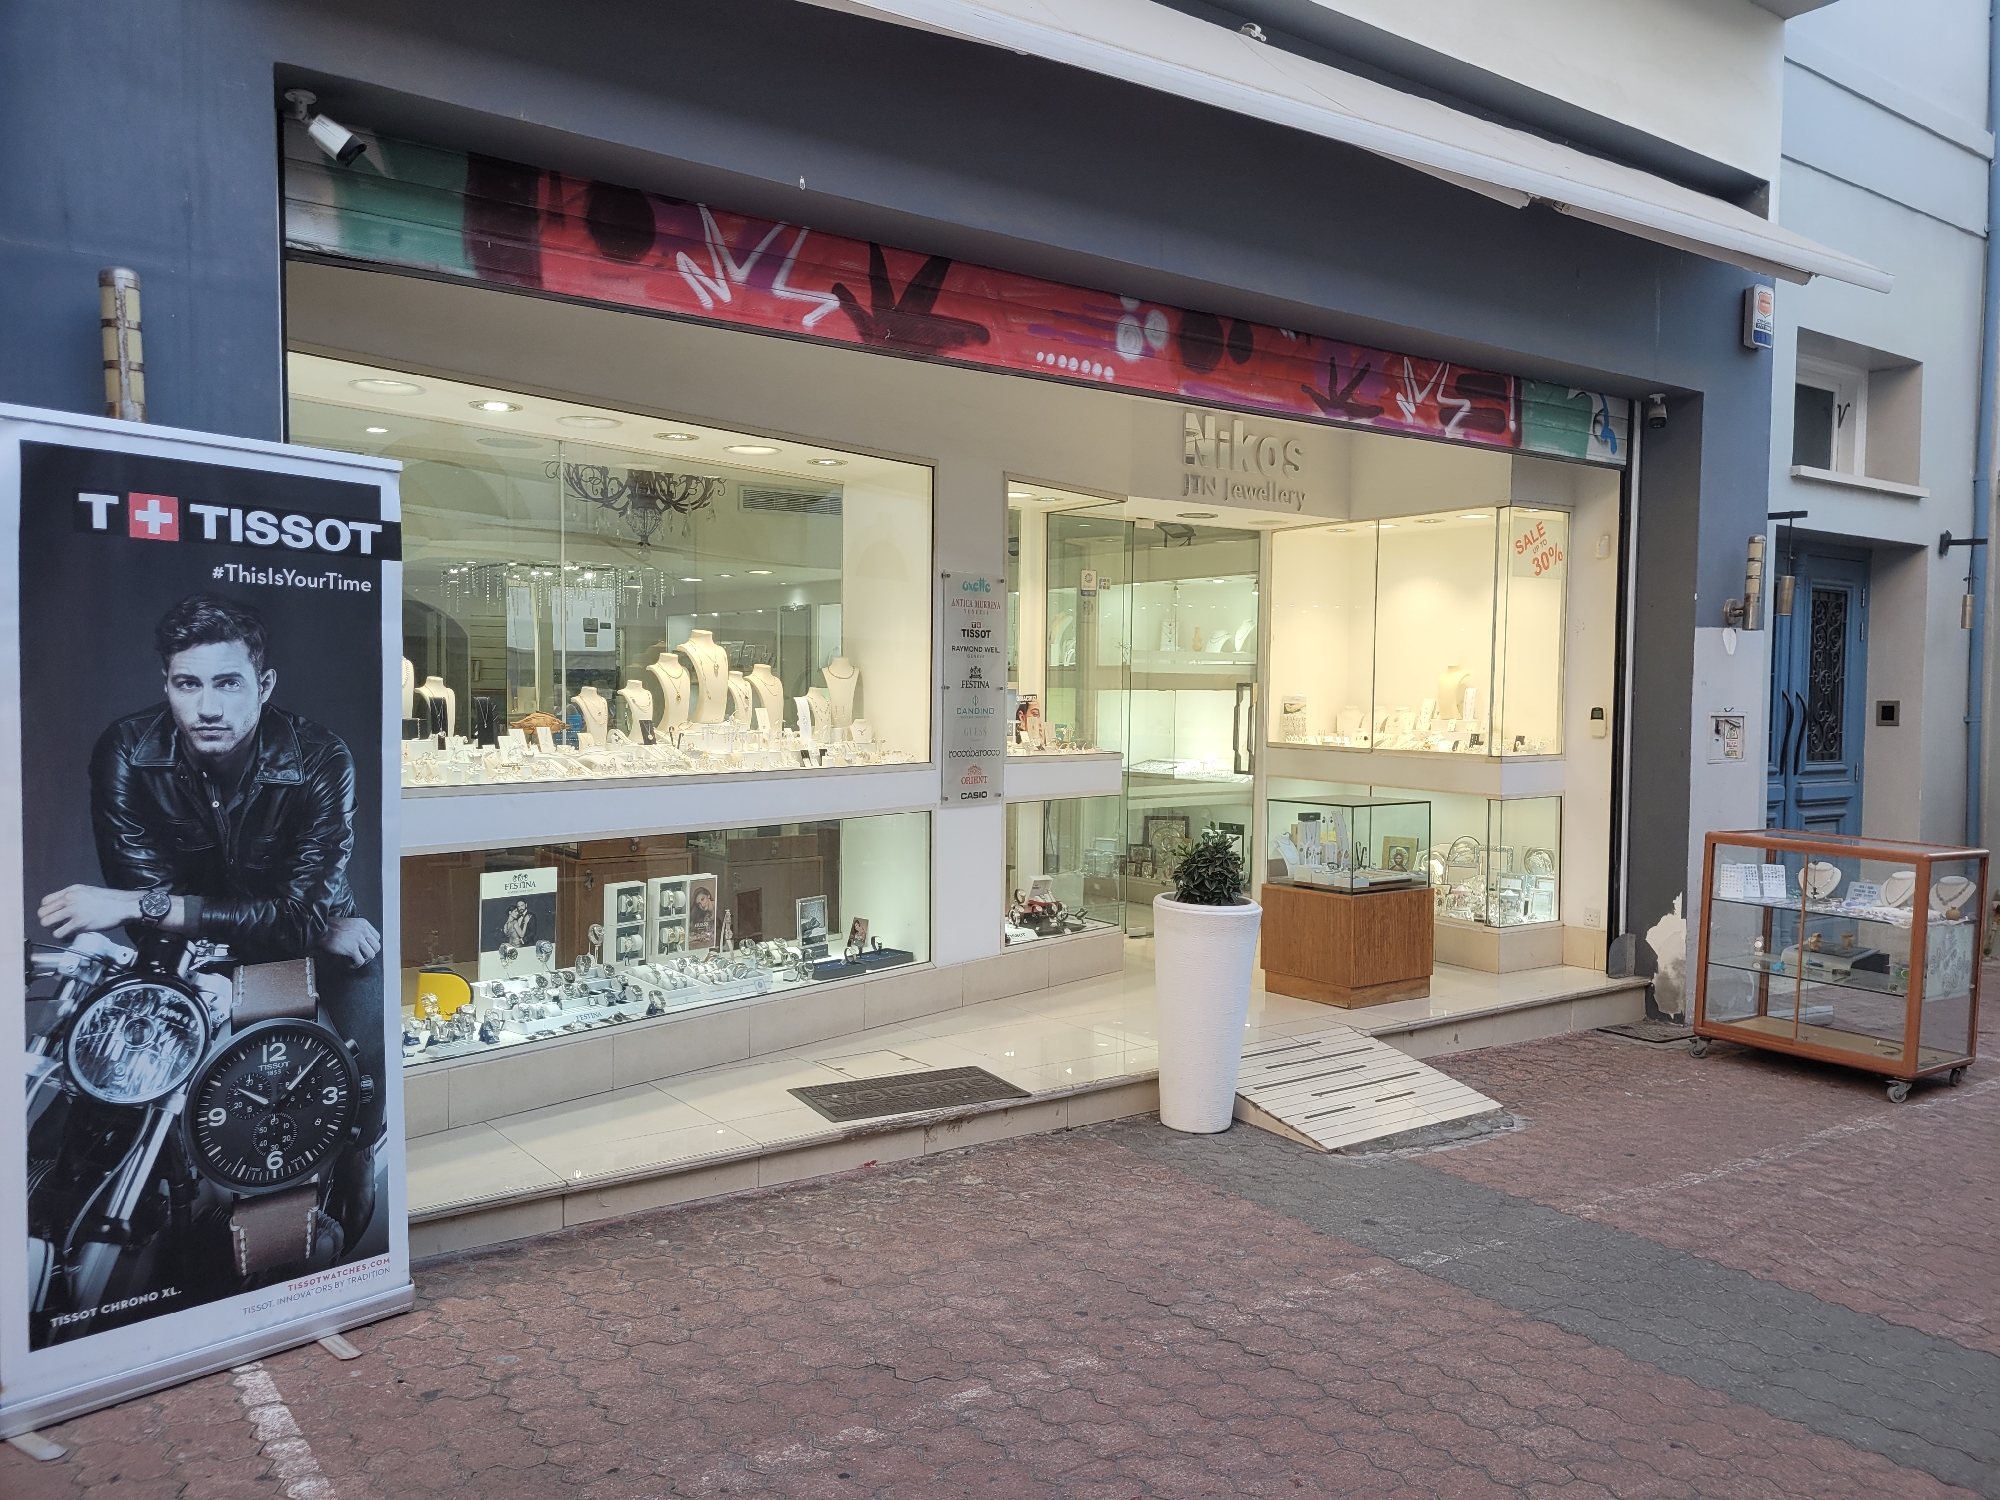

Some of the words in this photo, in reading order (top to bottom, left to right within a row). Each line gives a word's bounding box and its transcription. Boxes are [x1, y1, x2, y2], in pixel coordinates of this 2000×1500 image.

[1183, 411, 1306, 480] Nikos
[1183, 472, 1216, 497] JTN
[1224, 477, 1306, 511] Jewellery
[78, 492, 119, 530] T
[189, 503, 382, 555] TISSOT
[1515, 521, 1546, 554] SALE
[1532, 544, 1540, 554] UP
[1539, 538, 1548, 548] TO
[1532, 542, 1564, 576] 30%
[212, 563, 372, 593] #ThisIsYourTime
[951, 598, 973, 608] ANTICA
[961, 629, 992, 638] TISSOT
[961, 680, 990, 688] FESTINA
[964, 727, 987, 736] GUESS
[948, 748, 1000, 758] roccobarocco
[961, 776, 988, 784] ORIENT
[960, 791, 988, 800] CASIO
[504, 881, 536, 890] FESTINA
[262, 1042, 286, 1063] 12
[258, 1060, 291, 1071] TISSOT
[322, 1086, 338, 1104] 3
[208, 1107, 227, 1126] 9
[266, 1150, 284, 1170] 6
[288, 1257, 390, 1292] TISSOTWATCHES.COM
[243, 1300, 276, 1315] TISSOT,
[277, 1283, 332, 1306] INNOVATORS
[334, 1280, 345, 1289] BY
[348, 1267, 391, 1285] TRADITION
[50, 1307, 98, 1328] TISSOT
[100, 1291, 158, 1314] CHRONO
[161, 1286, 182, 1299] XL.
